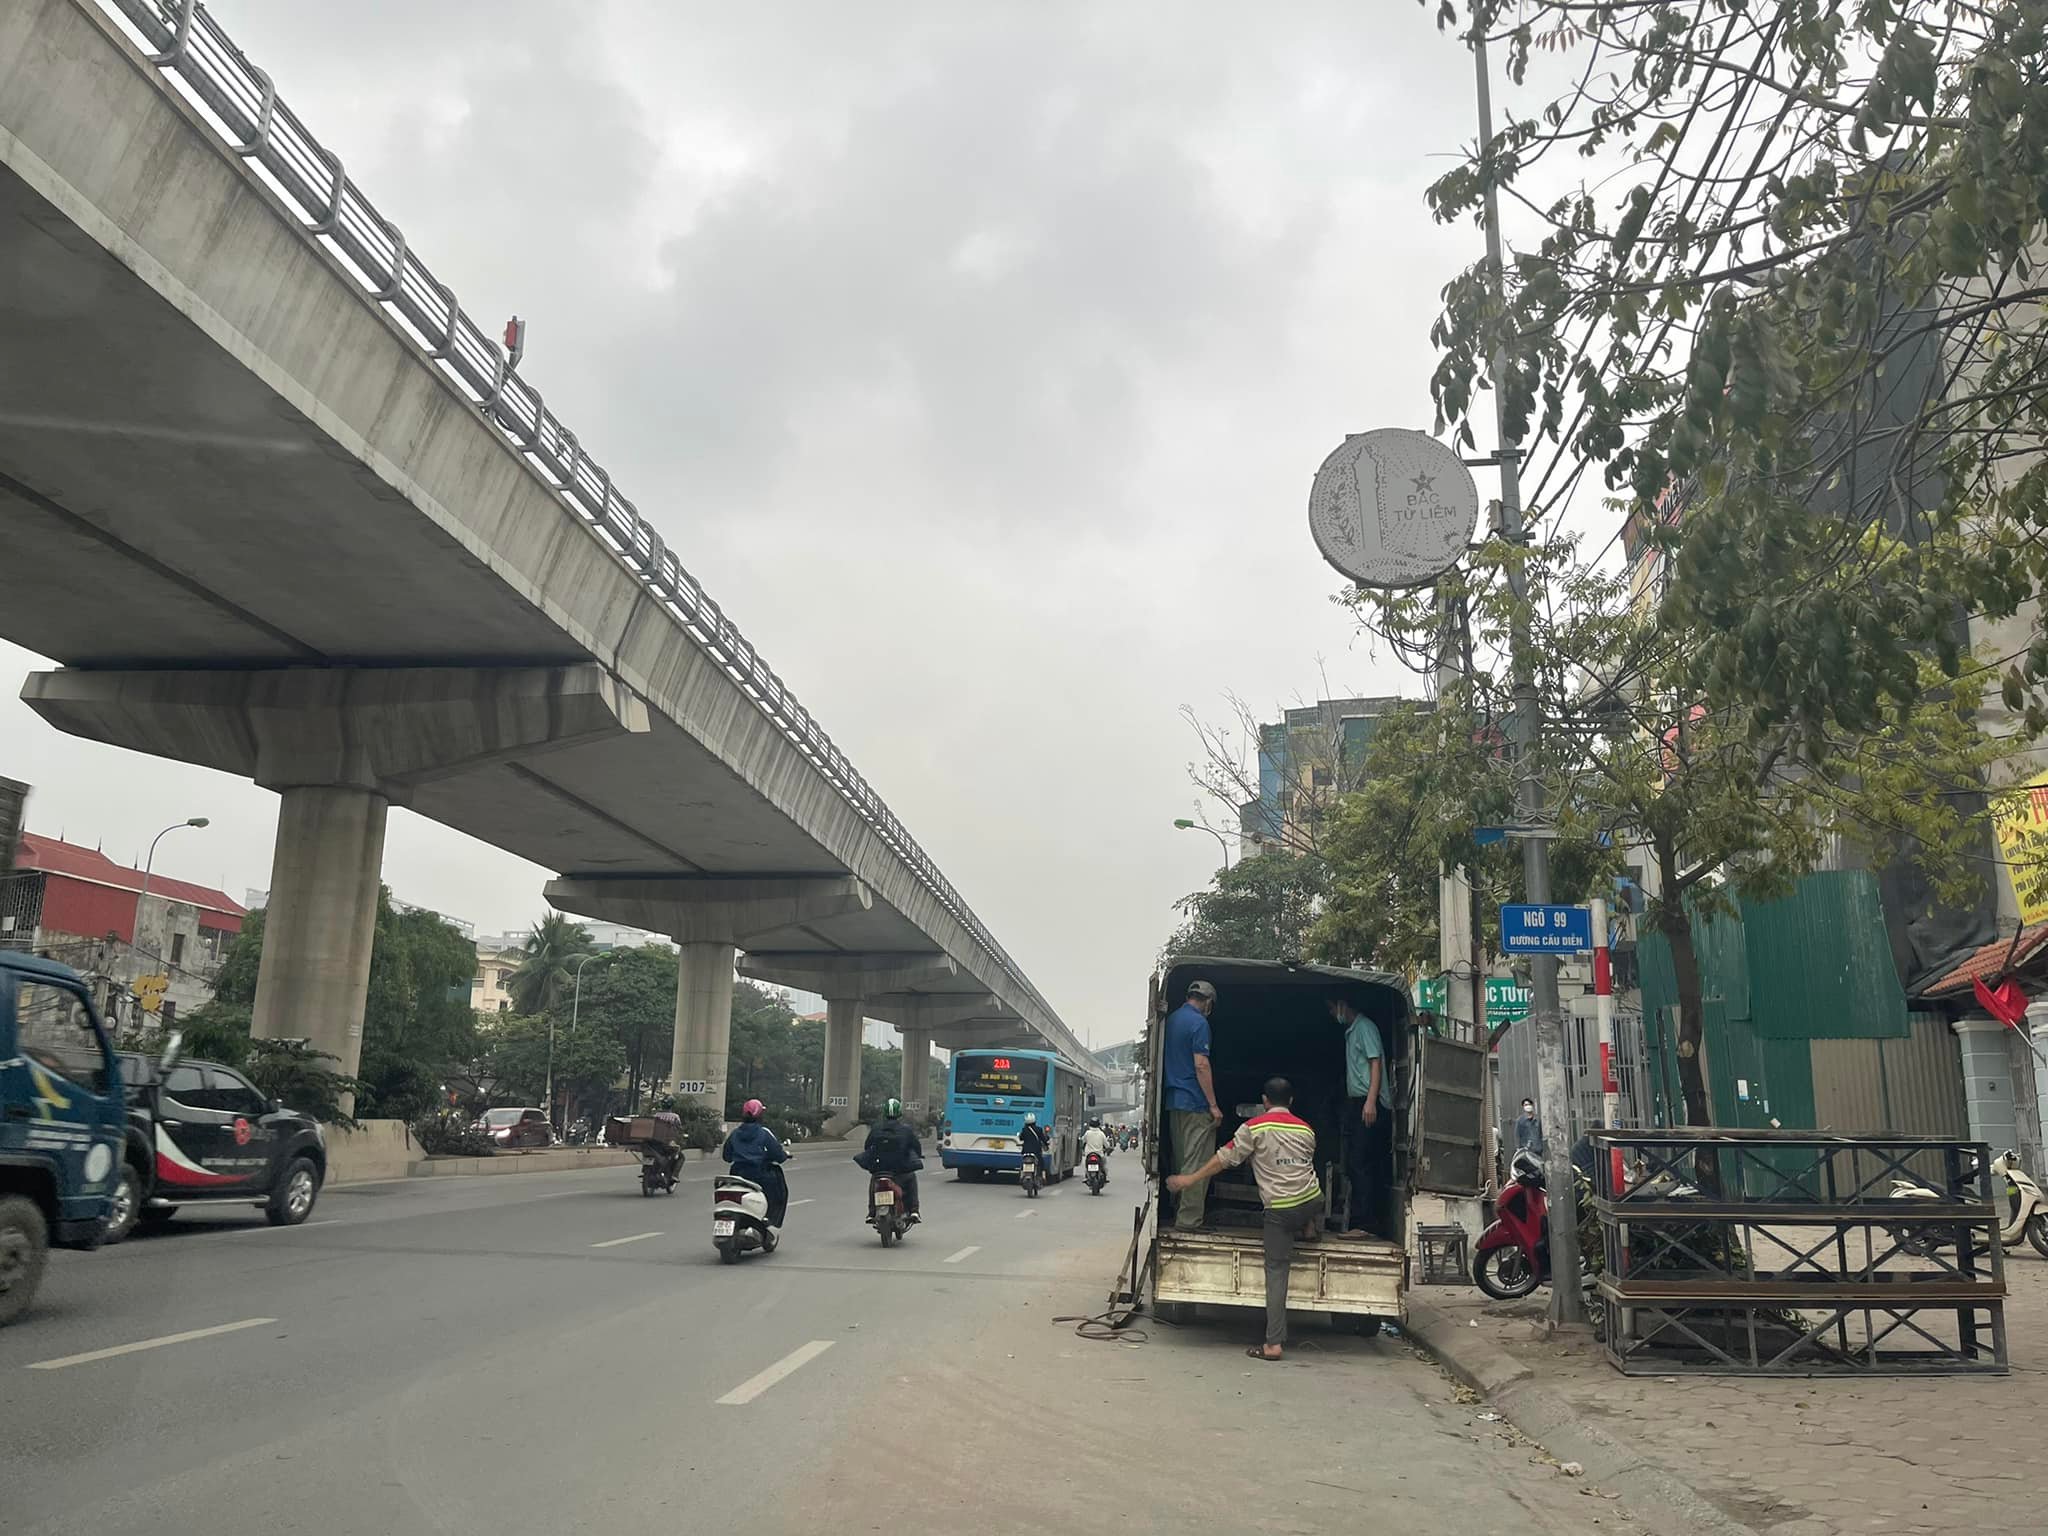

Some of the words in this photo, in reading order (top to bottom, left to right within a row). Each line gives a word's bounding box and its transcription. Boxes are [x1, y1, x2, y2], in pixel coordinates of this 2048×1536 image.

[1421, 505, 1456, 519] LIÊM
[1523, 908, 1545, 927] NGÕ
[1553, 911, 1567, 927] 99
[680, 1082, 705, 1092] P107
